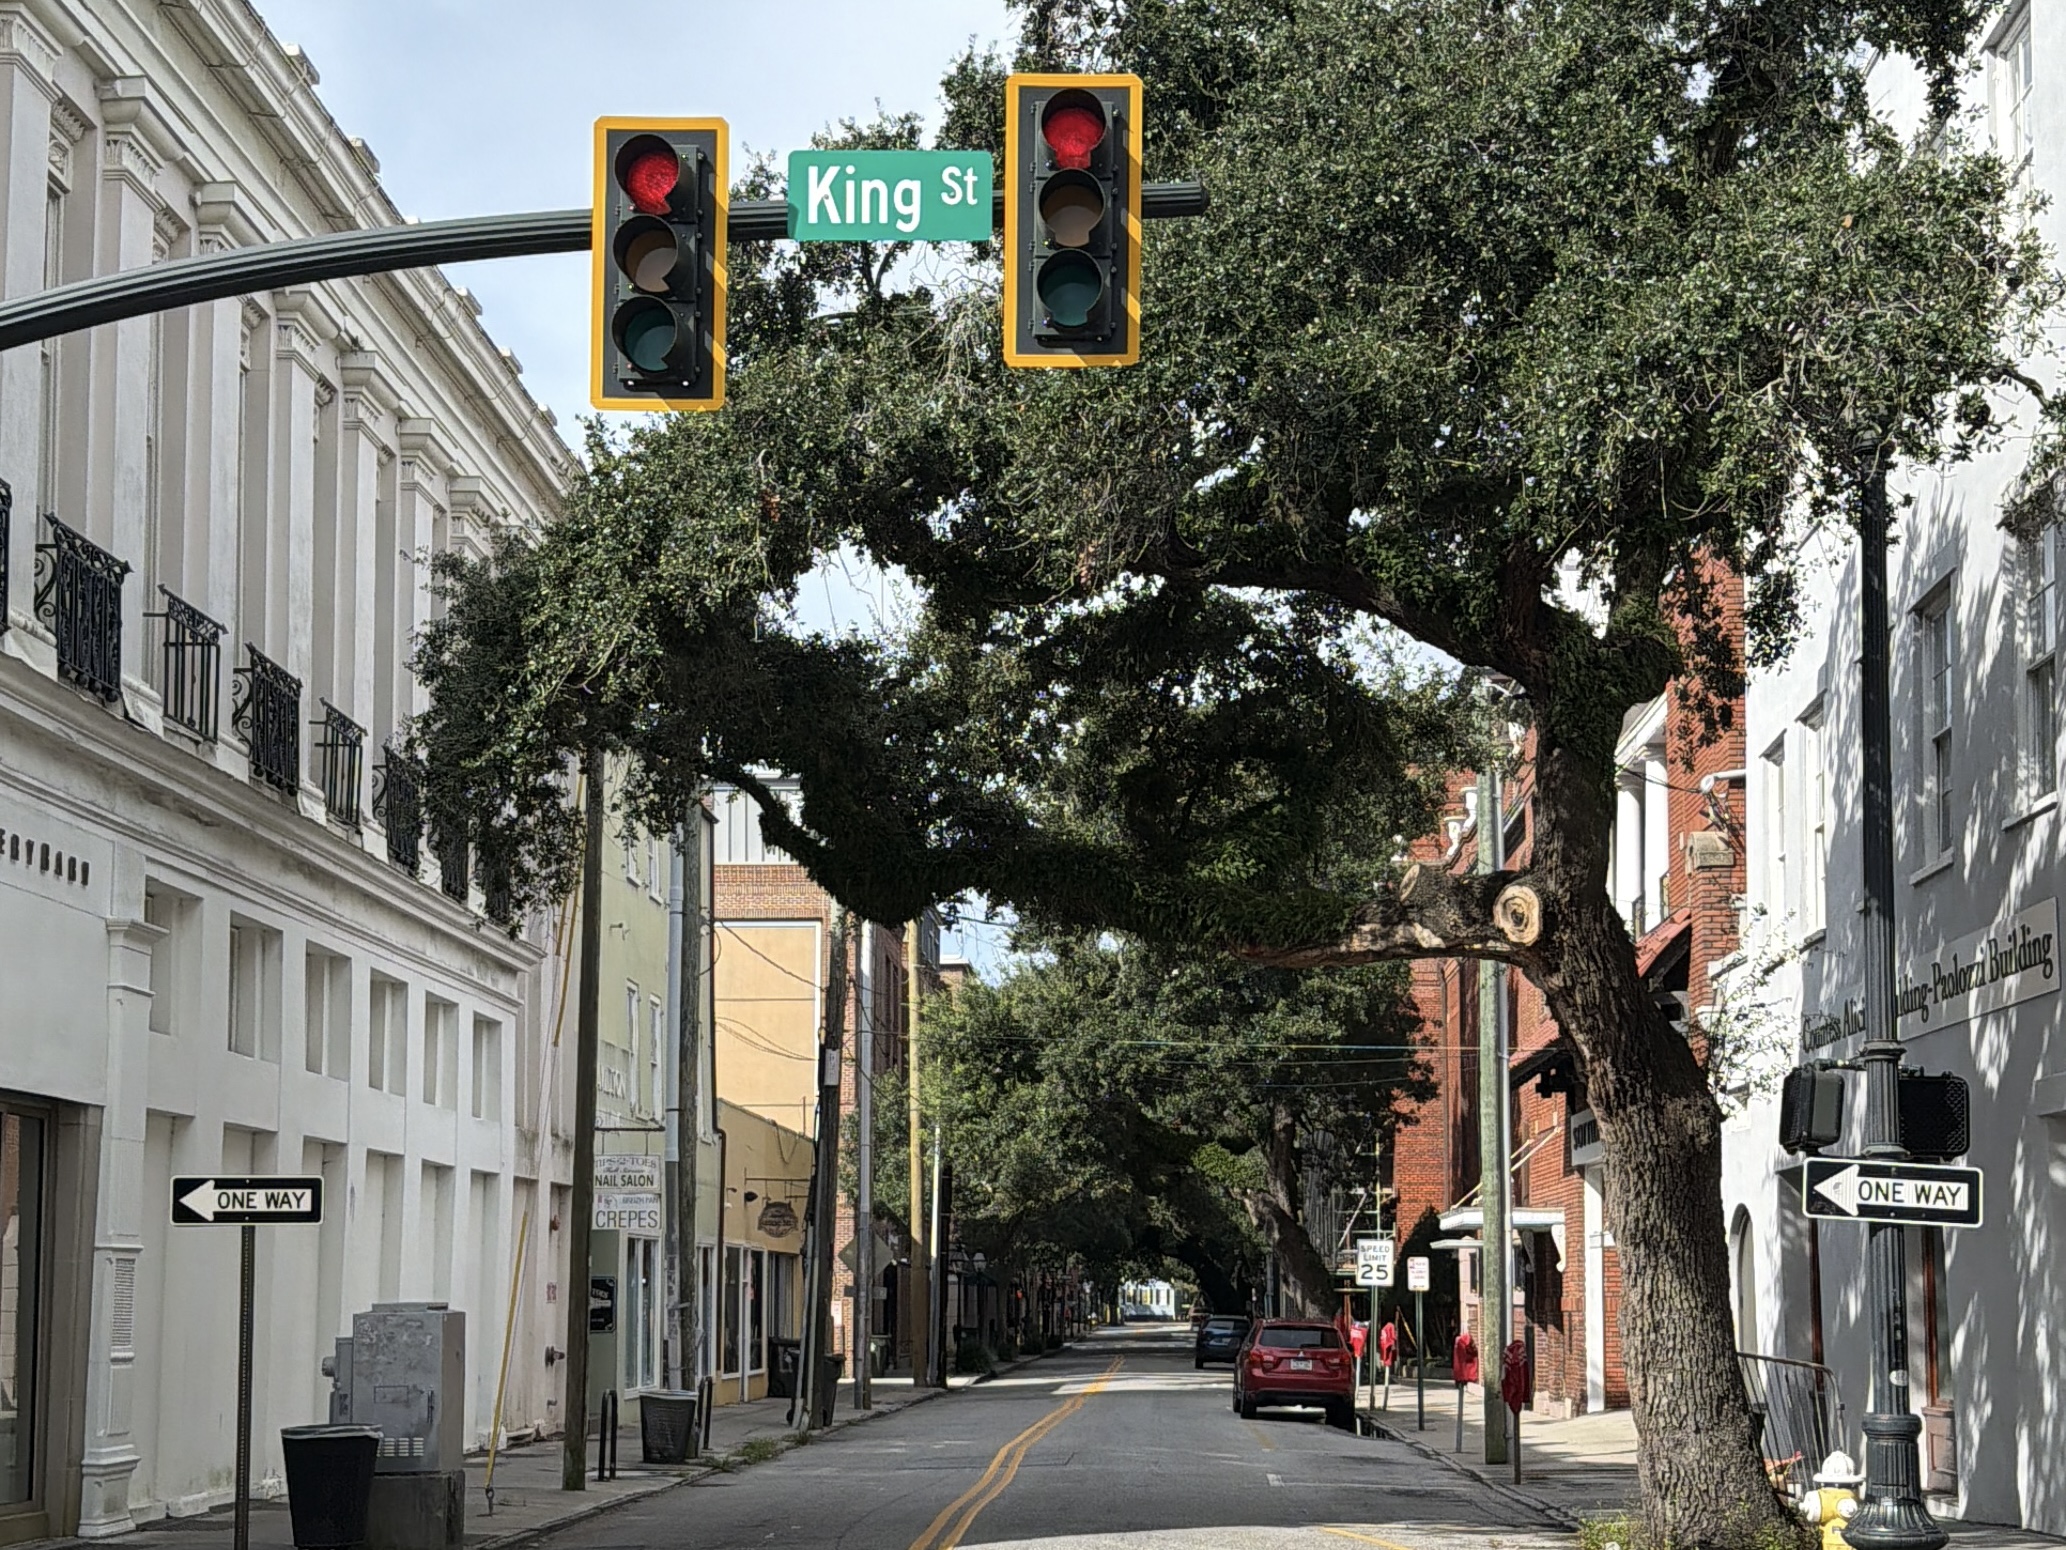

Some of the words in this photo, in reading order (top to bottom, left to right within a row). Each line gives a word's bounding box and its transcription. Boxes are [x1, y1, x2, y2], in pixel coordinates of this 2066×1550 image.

[808, 165, 921, 232] King
[941, 166, 978, 205] St
[1987, 923, 2053, 984] Building
[595, 1174, 618, 1187] NAIL
[620, 1174, 654, 1187] SALON
[218, 1191, 257, 1209] ONE
[265, 1191, 306, 1209] WAY
[1858, 1180, 1905, 1203] ONE
[1914, 1183, 1961, 1206] WAY
[595, 1210, 658, 1228] CREPES
[1360, 1245, 1390, 1253] SPEED
[1363, 1253, 1387, 1261] LIMIT
[1361, 1264, 1388, 1280] 25
